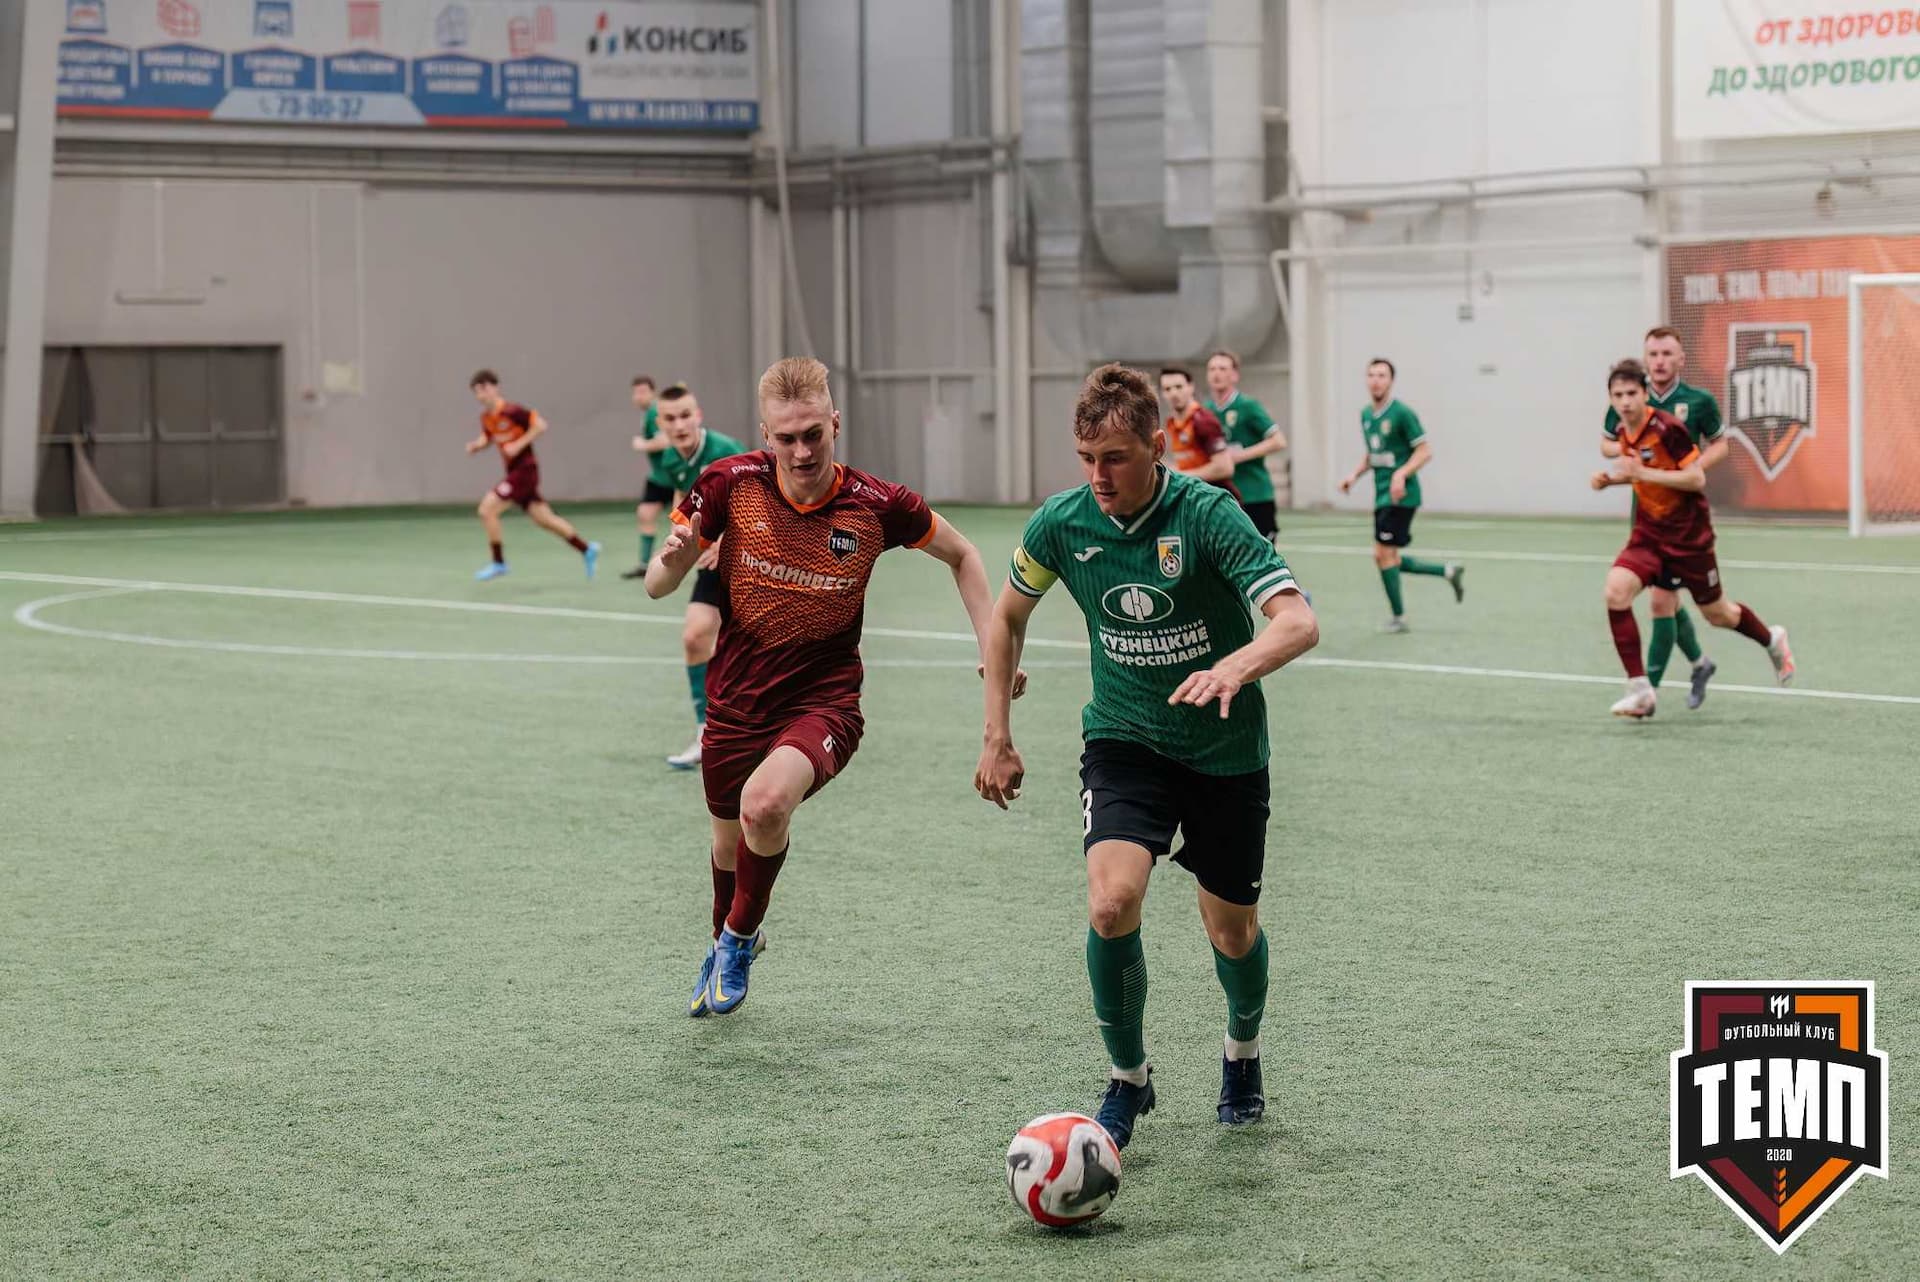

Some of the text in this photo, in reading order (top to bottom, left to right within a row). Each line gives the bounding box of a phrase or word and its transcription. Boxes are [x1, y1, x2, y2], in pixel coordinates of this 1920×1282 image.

[624, 26, 747, 53] КОНСИБ
[1754, 10, 1920, 46] ОТ ЗДОРОВ
[1707, 55, 1920, 96] ДО ЗДОРОВОГО
[1732, 366, 1807, 421] ТЕМП
[831, 537, 856, 552] ТЕМП
[1099, 625, 1209, 654] КУЗНЕЦКИЕ
